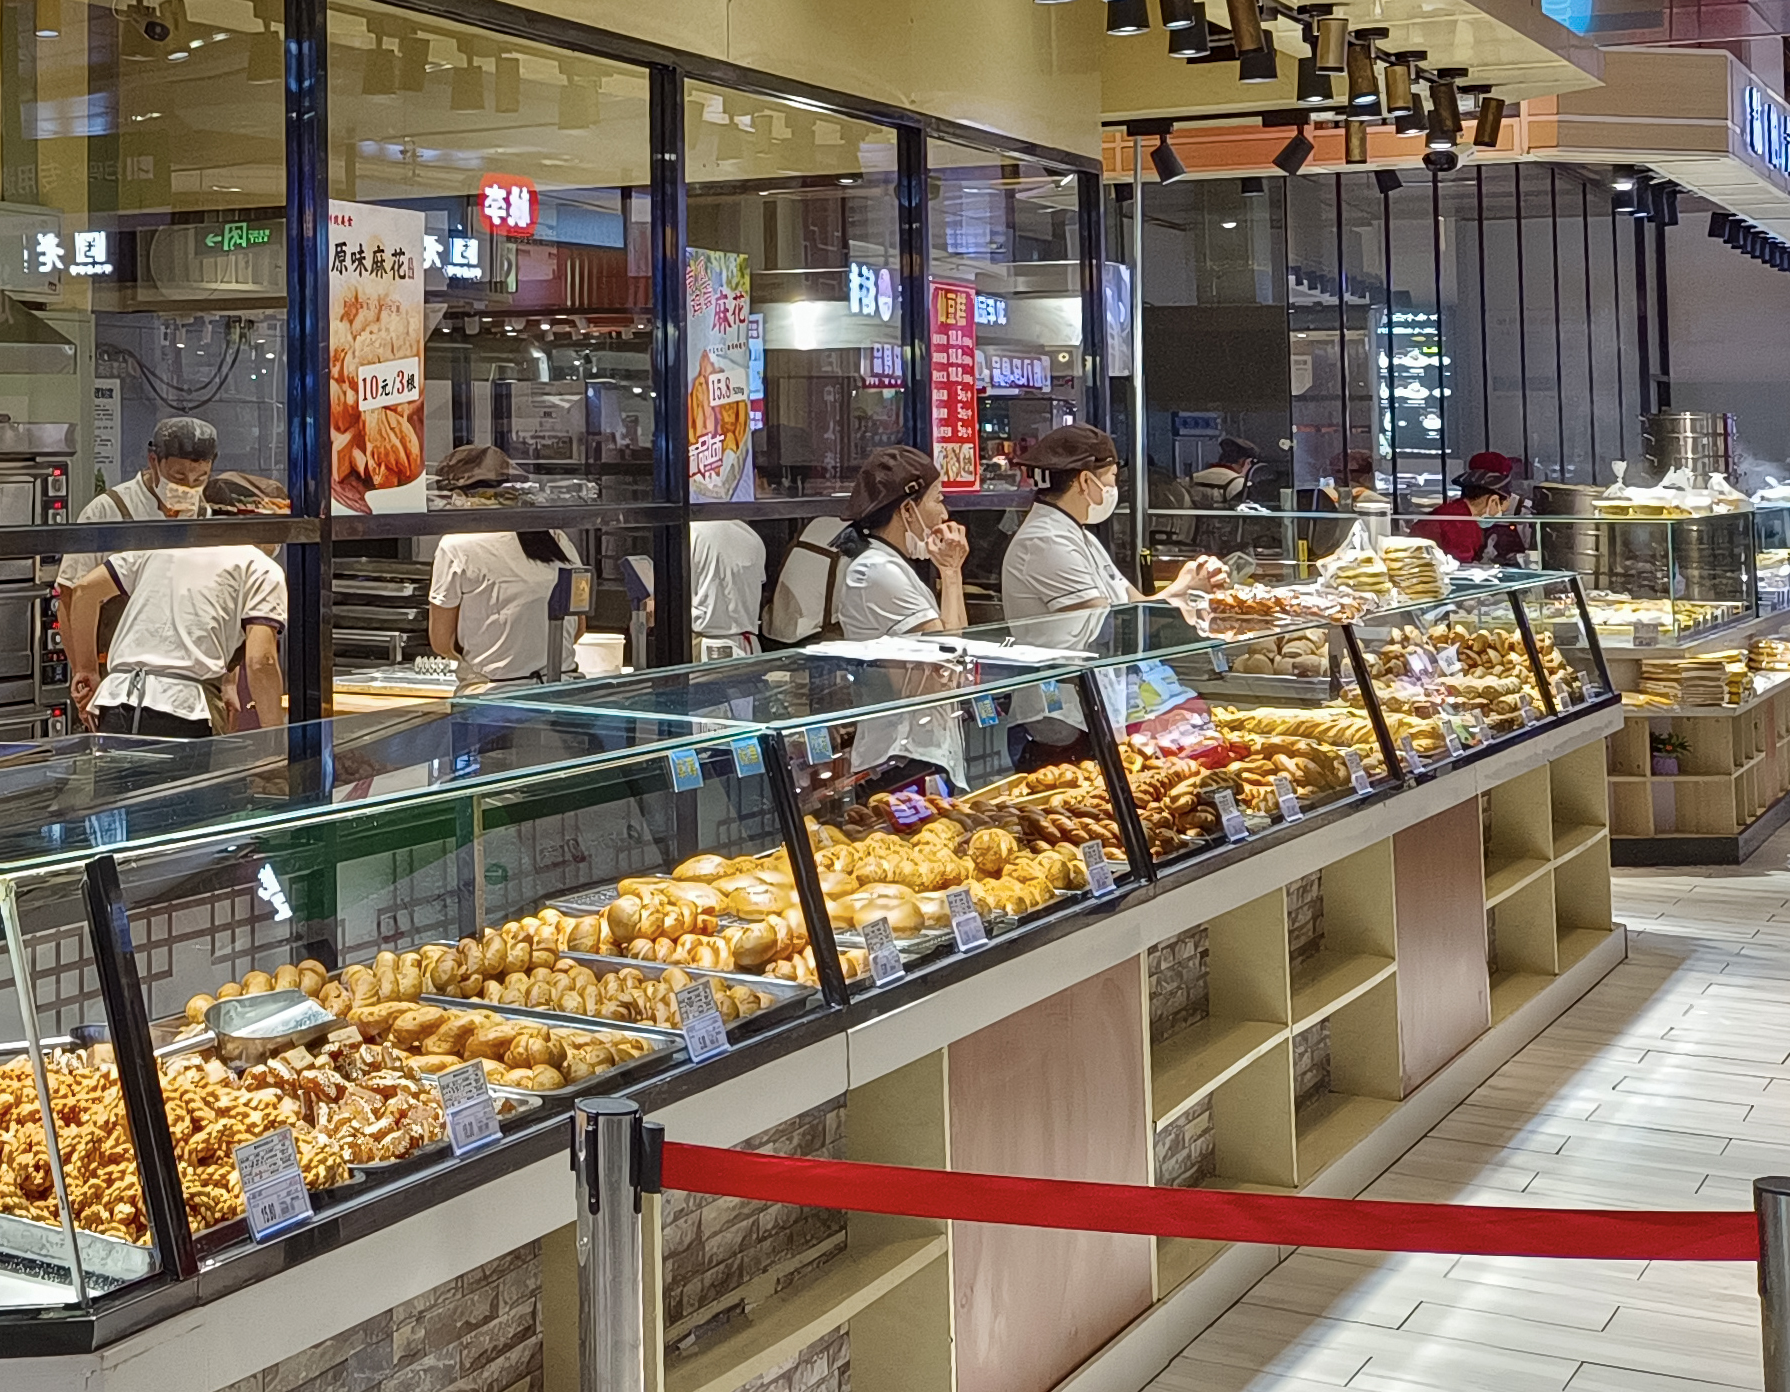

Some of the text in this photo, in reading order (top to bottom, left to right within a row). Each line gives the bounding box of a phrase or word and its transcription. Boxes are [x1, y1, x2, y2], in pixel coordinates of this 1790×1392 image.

[330, 241, 406, 281] 原味麻花
[712, 289, 747, 335] 麻花
[362, 370, 416, 401] 10元/3根
